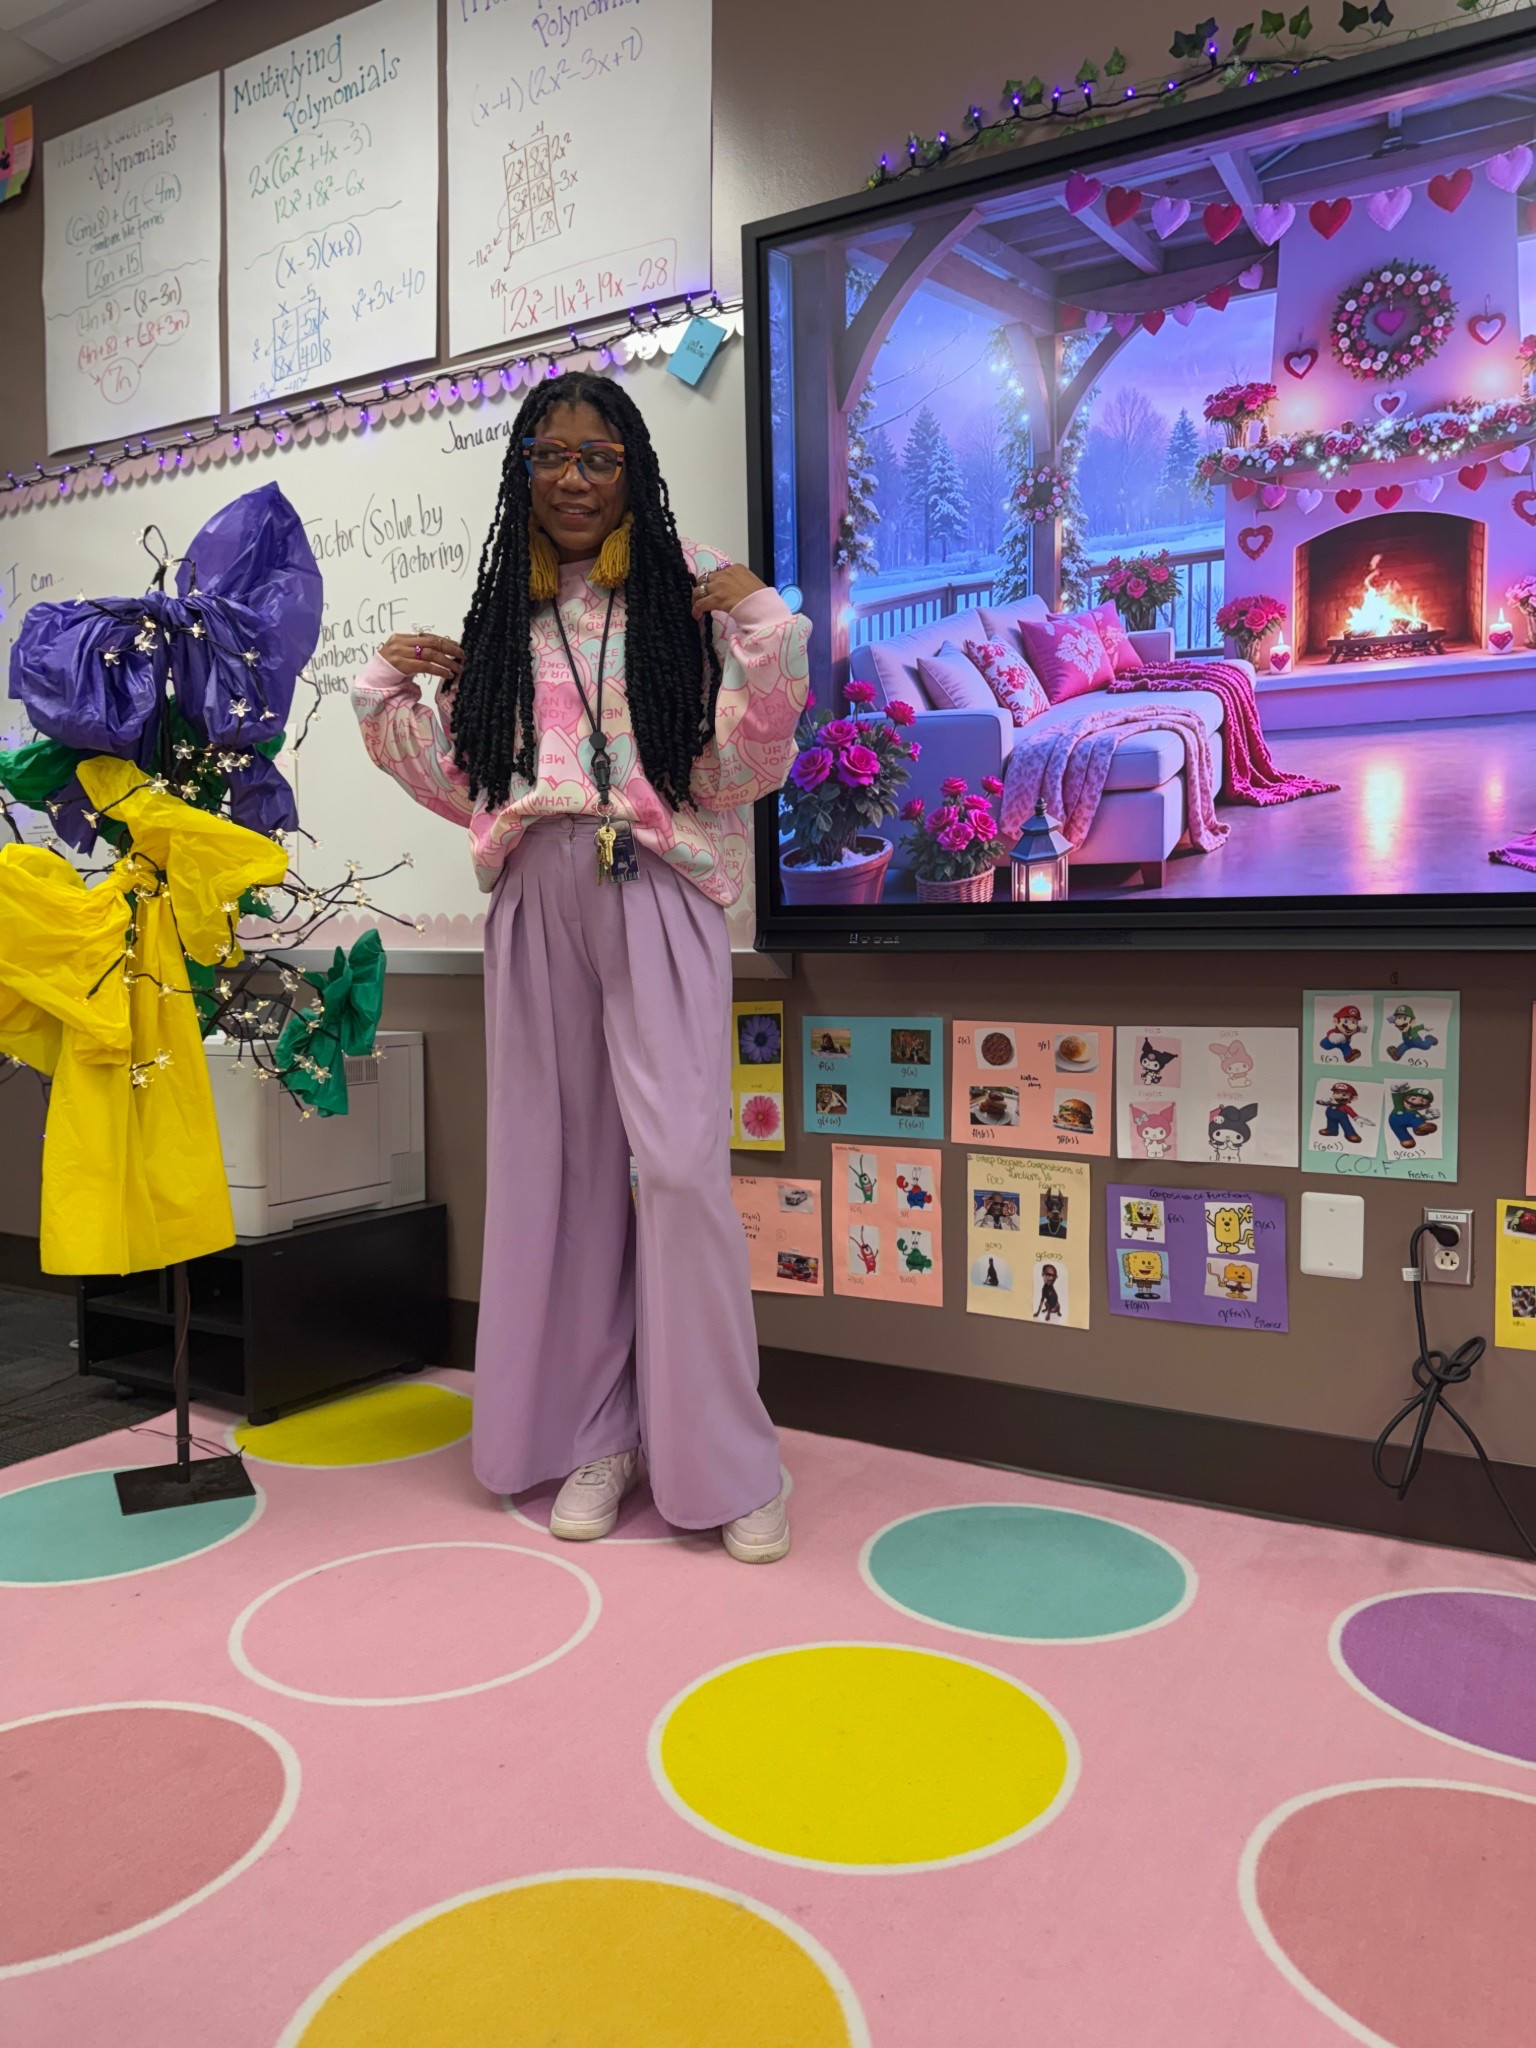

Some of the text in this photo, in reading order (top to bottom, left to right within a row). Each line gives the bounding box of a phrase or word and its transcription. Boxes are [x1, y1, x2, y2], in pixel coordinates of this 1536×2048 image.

[233, 33, 343, 114] Multiplying
[283, 48, 400, 133] Polynomials
[89, 129, 177, 193] Polynomials
[442, 420, 513, 456] January
[417, 493, 443, 536] by
[343, 619, 354, 639] a
[358, 597, 408, 634] GCF
[748, 652, 778, 668] MEH
[532, 796, 580, 808] WHAT-
